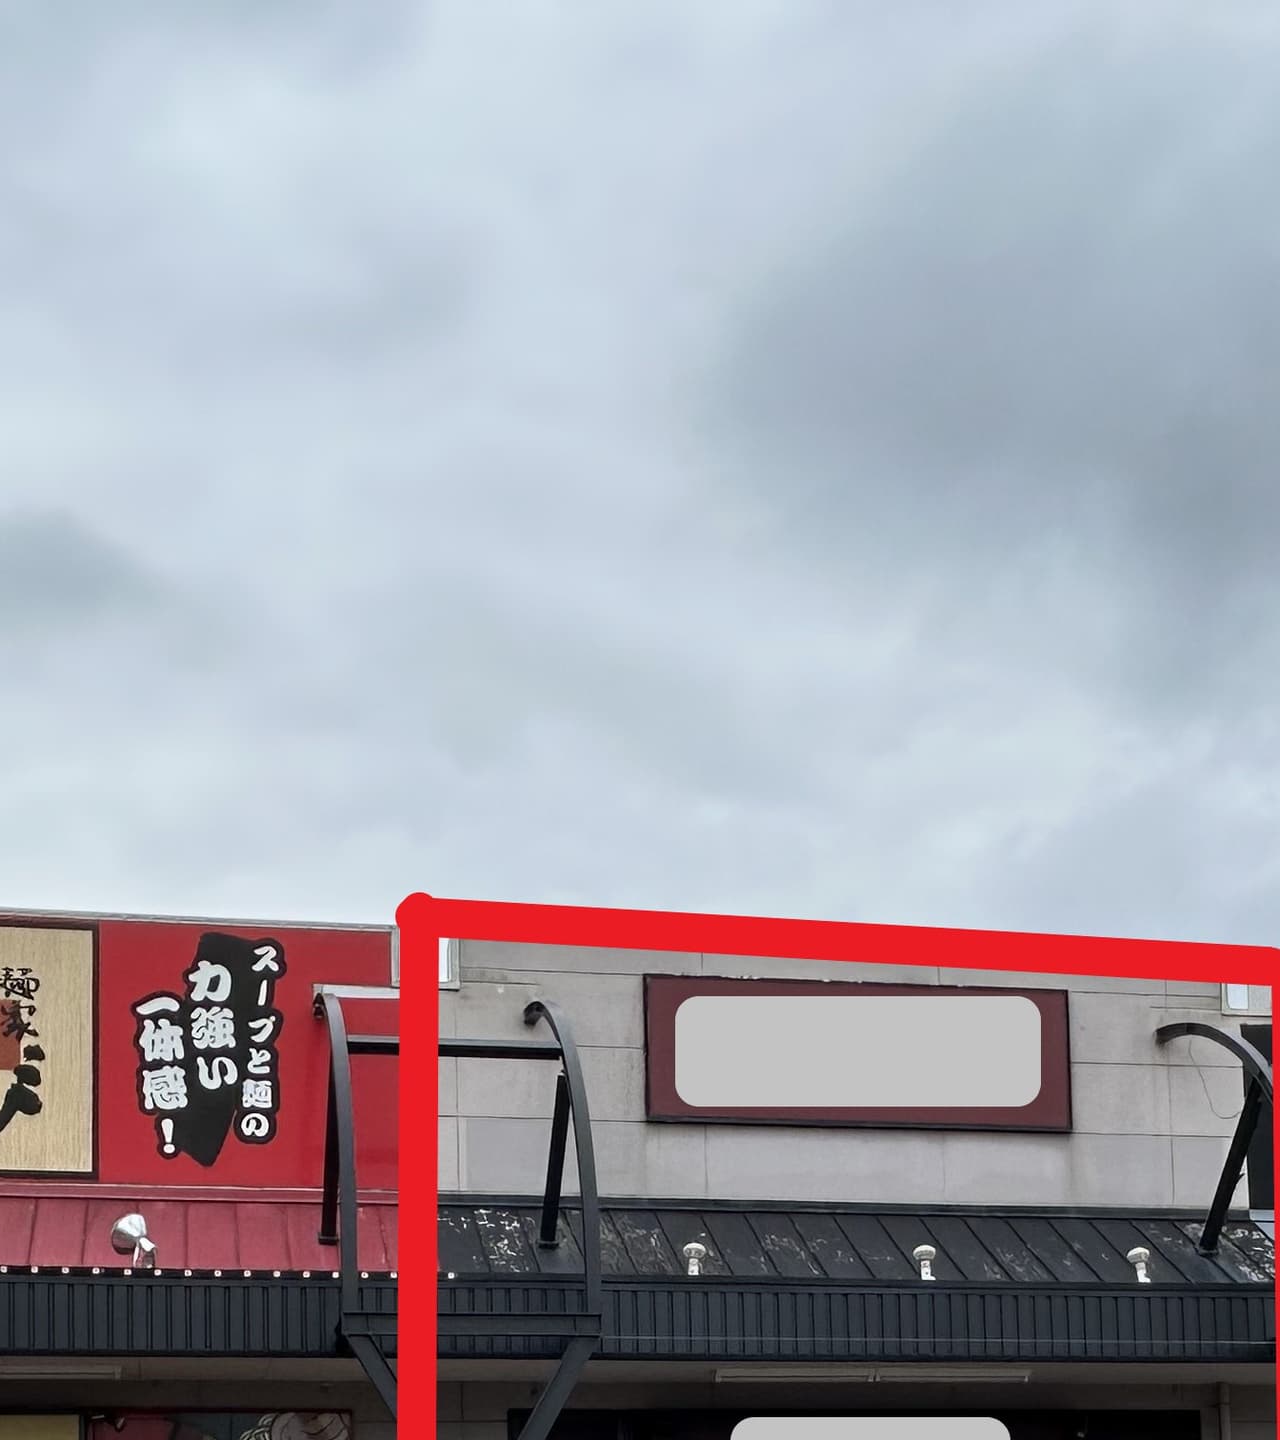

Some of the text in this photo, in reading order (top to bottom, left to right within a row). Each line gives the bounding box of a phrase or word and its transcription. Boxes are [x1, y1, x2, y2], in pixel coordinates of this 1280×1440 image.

[135, 996, 189, 1155] 一体感！
[187, 959, 239, 1090] 力強い
[240, 945, 280, 1138] スープと麺の
